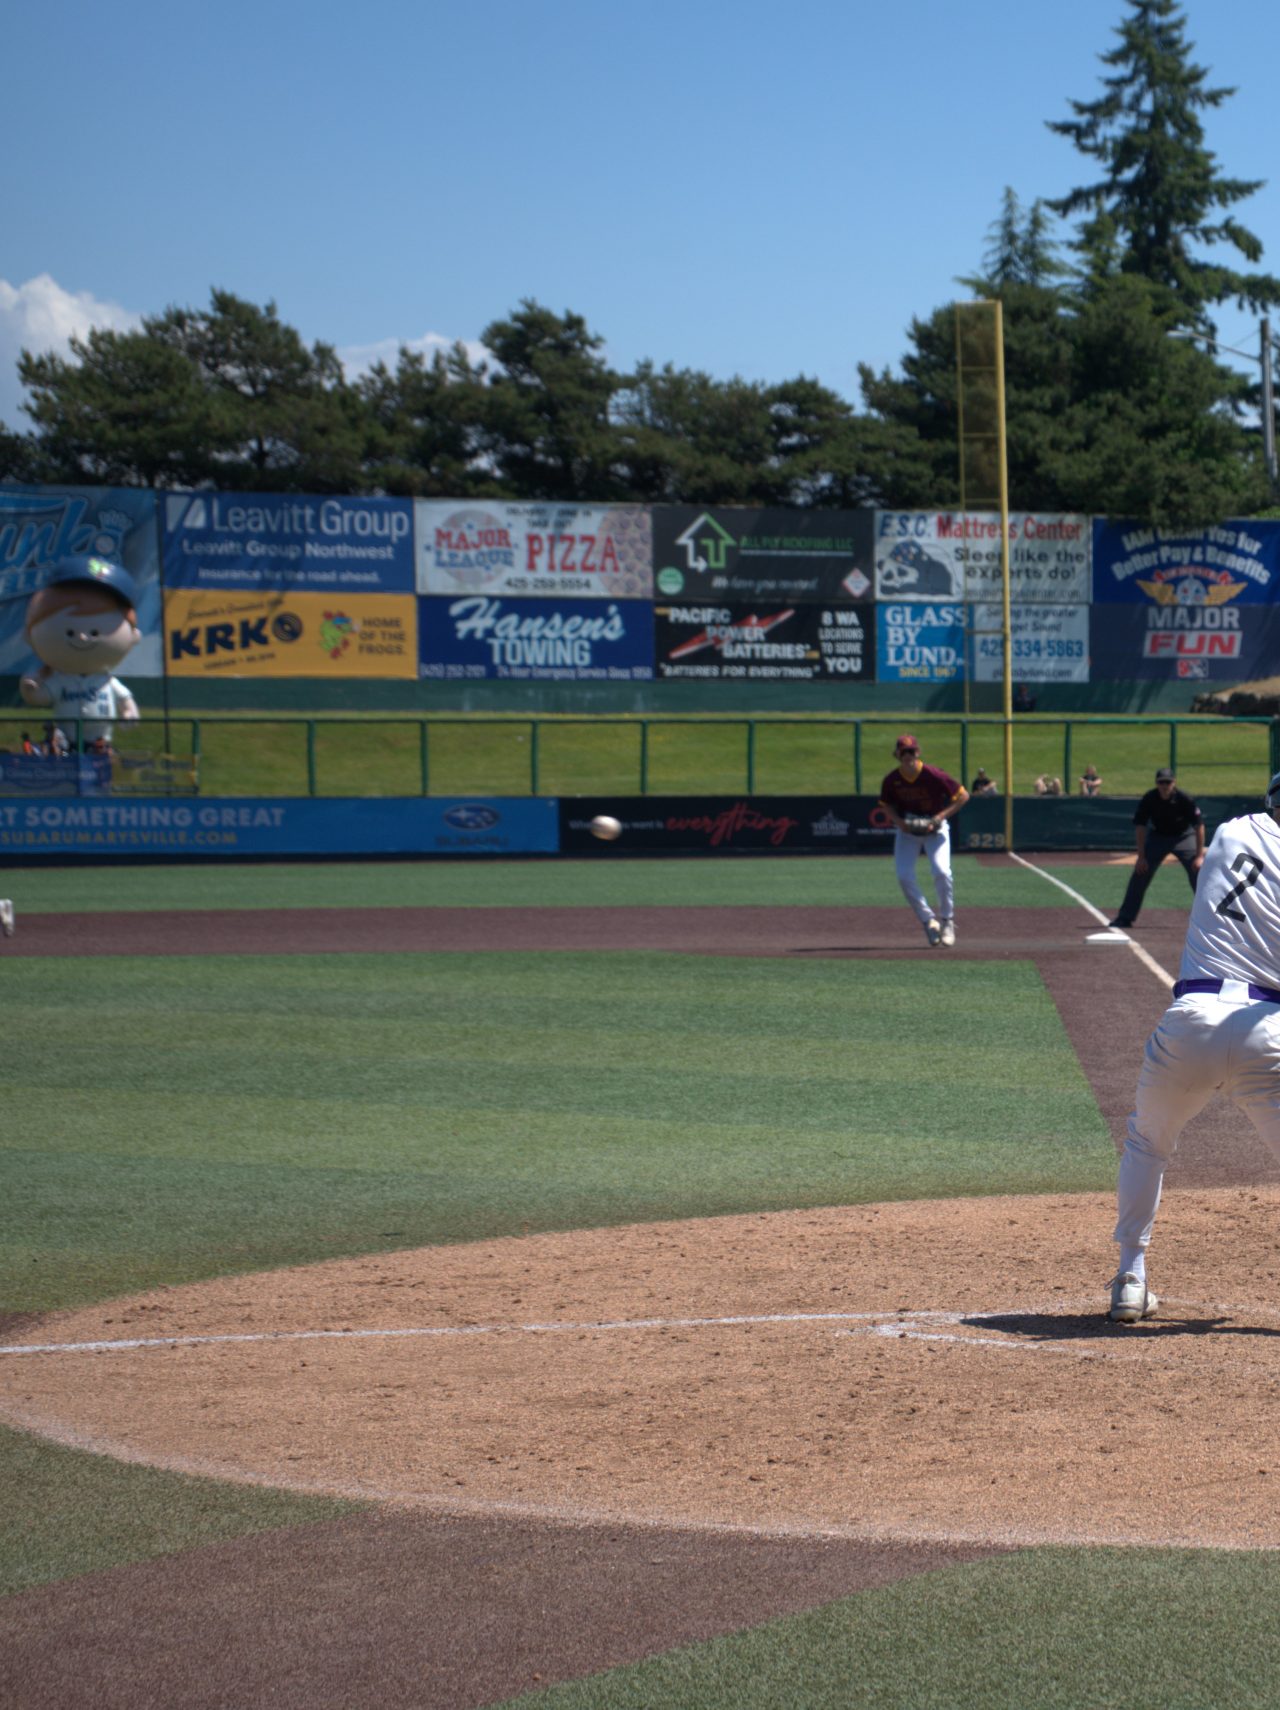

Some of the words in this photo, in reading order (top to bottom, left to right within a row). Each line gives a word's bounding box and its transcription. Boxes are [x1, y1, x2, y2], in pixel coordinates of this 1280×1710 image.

[213, 498, 315, 534] Leavitt
[320, 500, 410, 544] Group
[1023, 516, 1083, 541] Center
[434, 527, 513, 551] MAJOR
[782, 537, 834, 549] ROOFING
[836, 538, 853, 550] LLC
[1207, 525, 1238, 547] Yes
[1236, 530, 1264, 556] for
[182, 539, 243, 556] Leavitt
[246, 540, 300, 560] Group
[305, 541, 394, 560] Northwest
[526, 533, 621, 573] PIZZA
[1013, 549, 1049, 563] like
[1055, 549, 1085, 564] the
[434, 550, 515, 569] LEAGUE
[1111, 548, 1159, 582] Better
[1159, 545, 1192, 566] Pay
[1192, 546, 1204, 562] &
[1205, 545, 1272, 586] Benefits
[199, 567, 261, 581] Insurance
[307, 570, 336, 582] road
[340, 570, 381, 583] ahead.
[1047, 566, 1076, 581] do!
[669, 608, 731, 623] PACIFIC
[821, 611, 832, 625] 8
[835, 611, 860, 626] WA
[885, 605, 968, 626] GLASS
[1022, 603, 1039, 615] the
[1040, 604, 1080, 618] greater
[1147, 607, 1241, 629] MAJOR
[362, 617, 403, 629] HOME
[449, 597, 625, 642] Hansen's
[1032, 619, 1063, 632] Sound
[359, 630, 376, 642] OF
[382, 630, 406, 643] THE
[706, 626, 765, 641] POWER
[818, 627, 864, 641] LOCATIONS
[886, 626, 921, 646] BY
[487, 638, 593, 667] TOWING
[820, 642, 831, 654] TO
[834, 642, 862, 655] SERVE
[1150, 634, 1238, 657] FUN
[722, 665, 746, 677] FOR
[824, 657, 862, 673] YOU
[899, 667, 929, 678] SINCE
[24, 806, 193, 827] SOMETHING
[198, 806, 286, 827] GREAT
[666, 800, 798, 846] everything
[969, 833, 1006, 848] 329
[1214, 852, 1264, 923] 2
